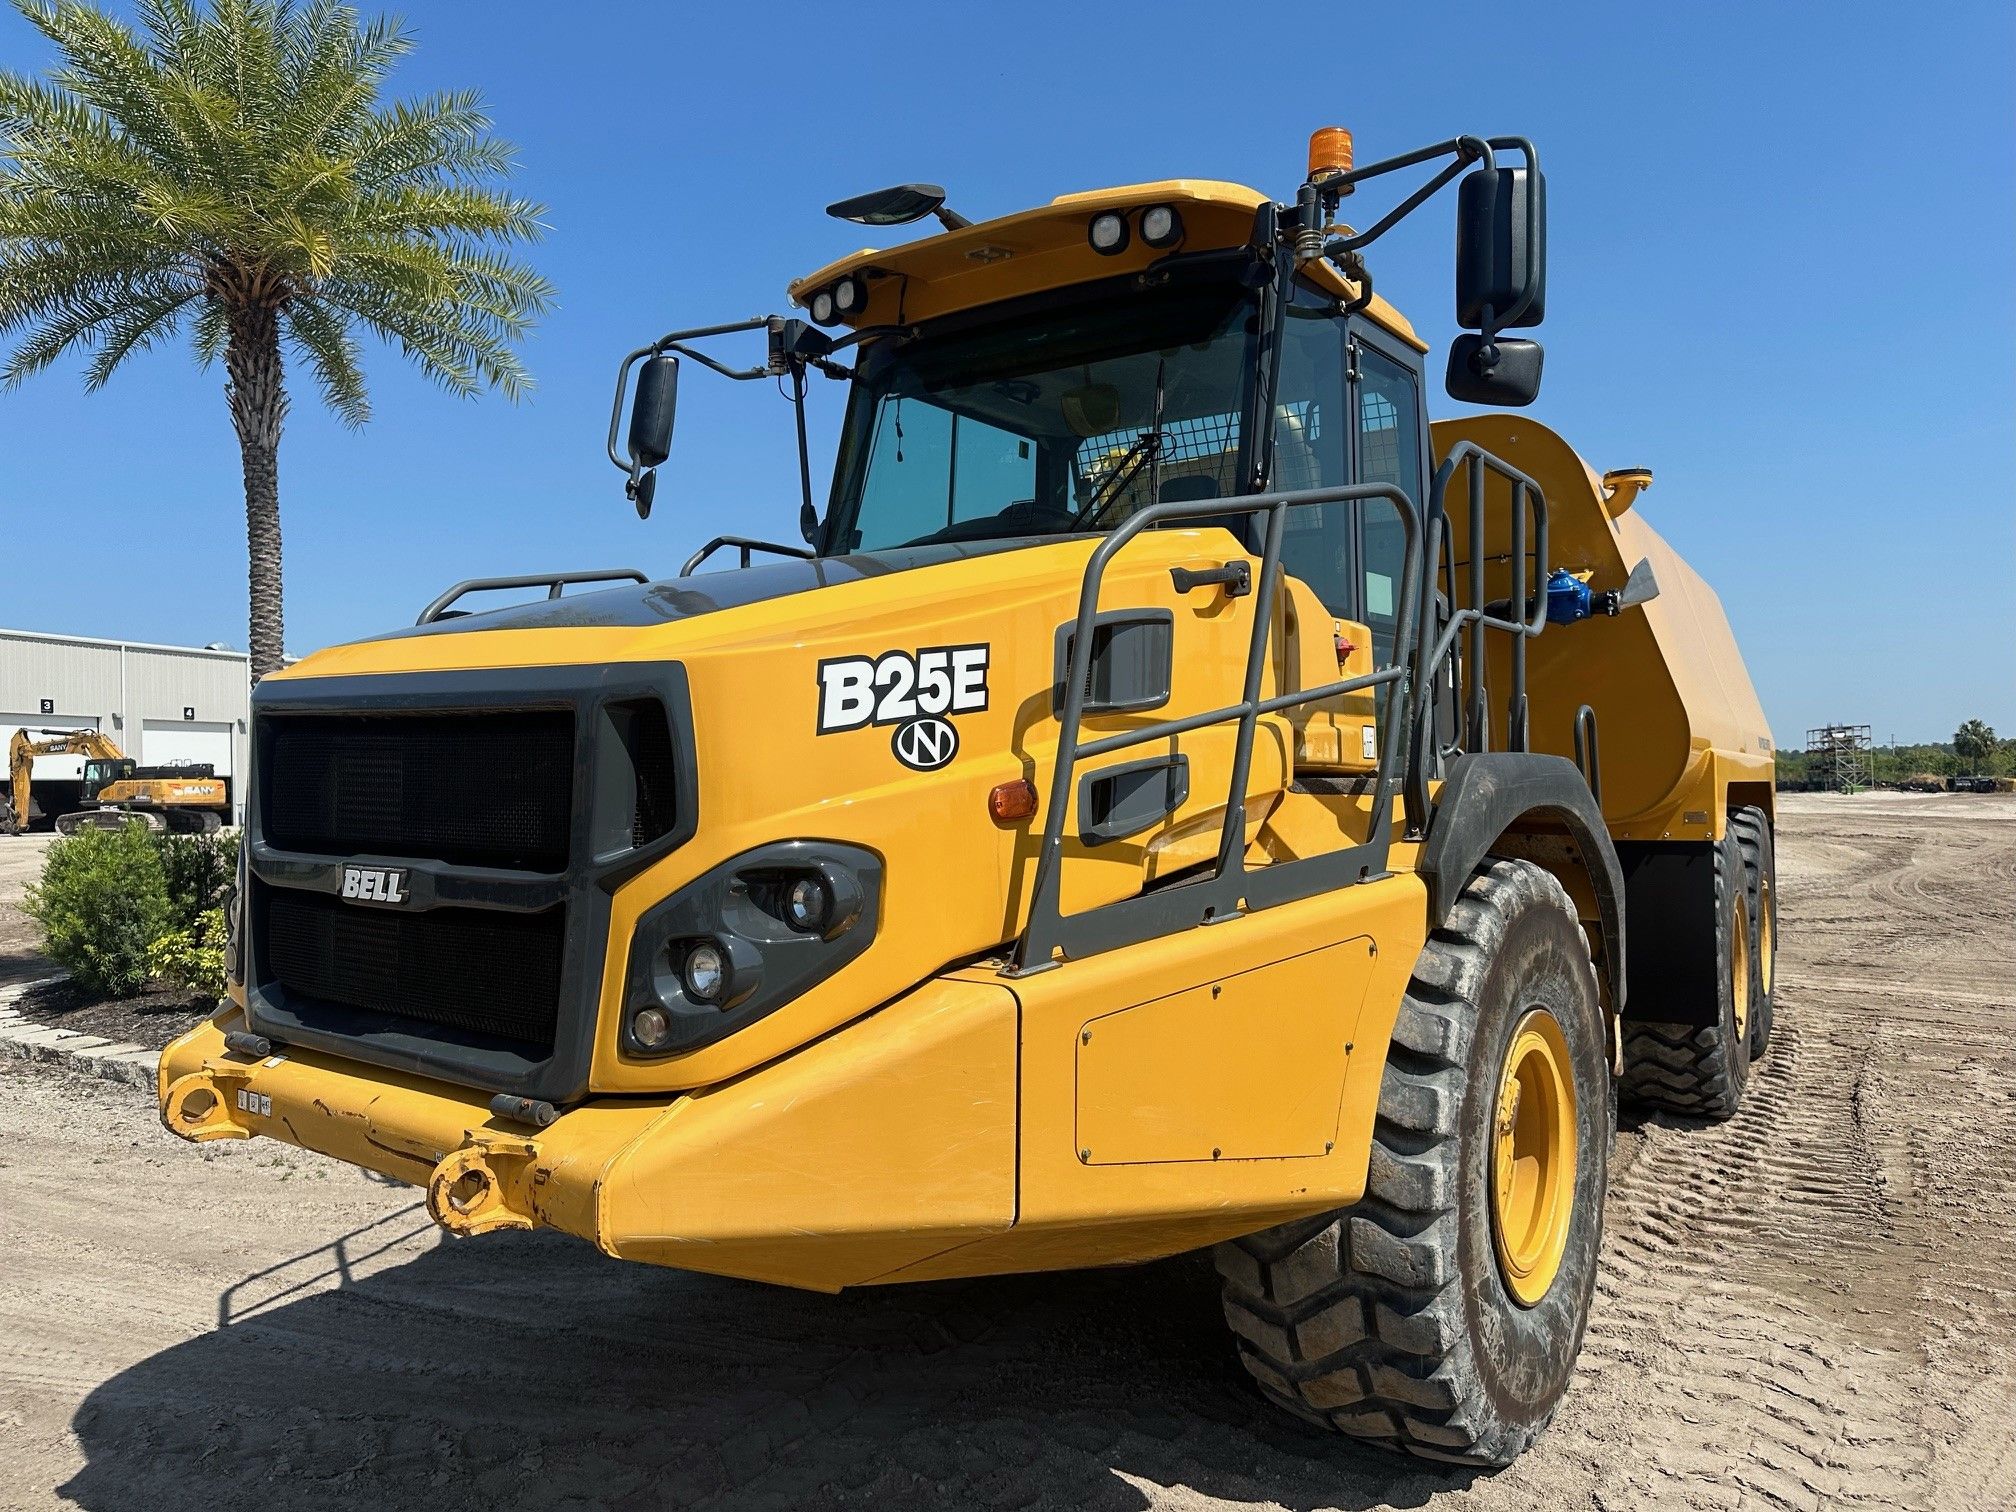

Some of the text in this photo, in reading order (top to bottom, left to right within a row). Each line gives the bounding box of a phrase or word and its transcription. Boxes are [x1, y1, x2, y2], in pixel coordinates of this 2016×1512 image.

[821, 648, 987, 729] B25E
[43, 701, 51, 710] 3
[186, 708, 193, 717] 4
[342, 869, 402, 903] BELL
